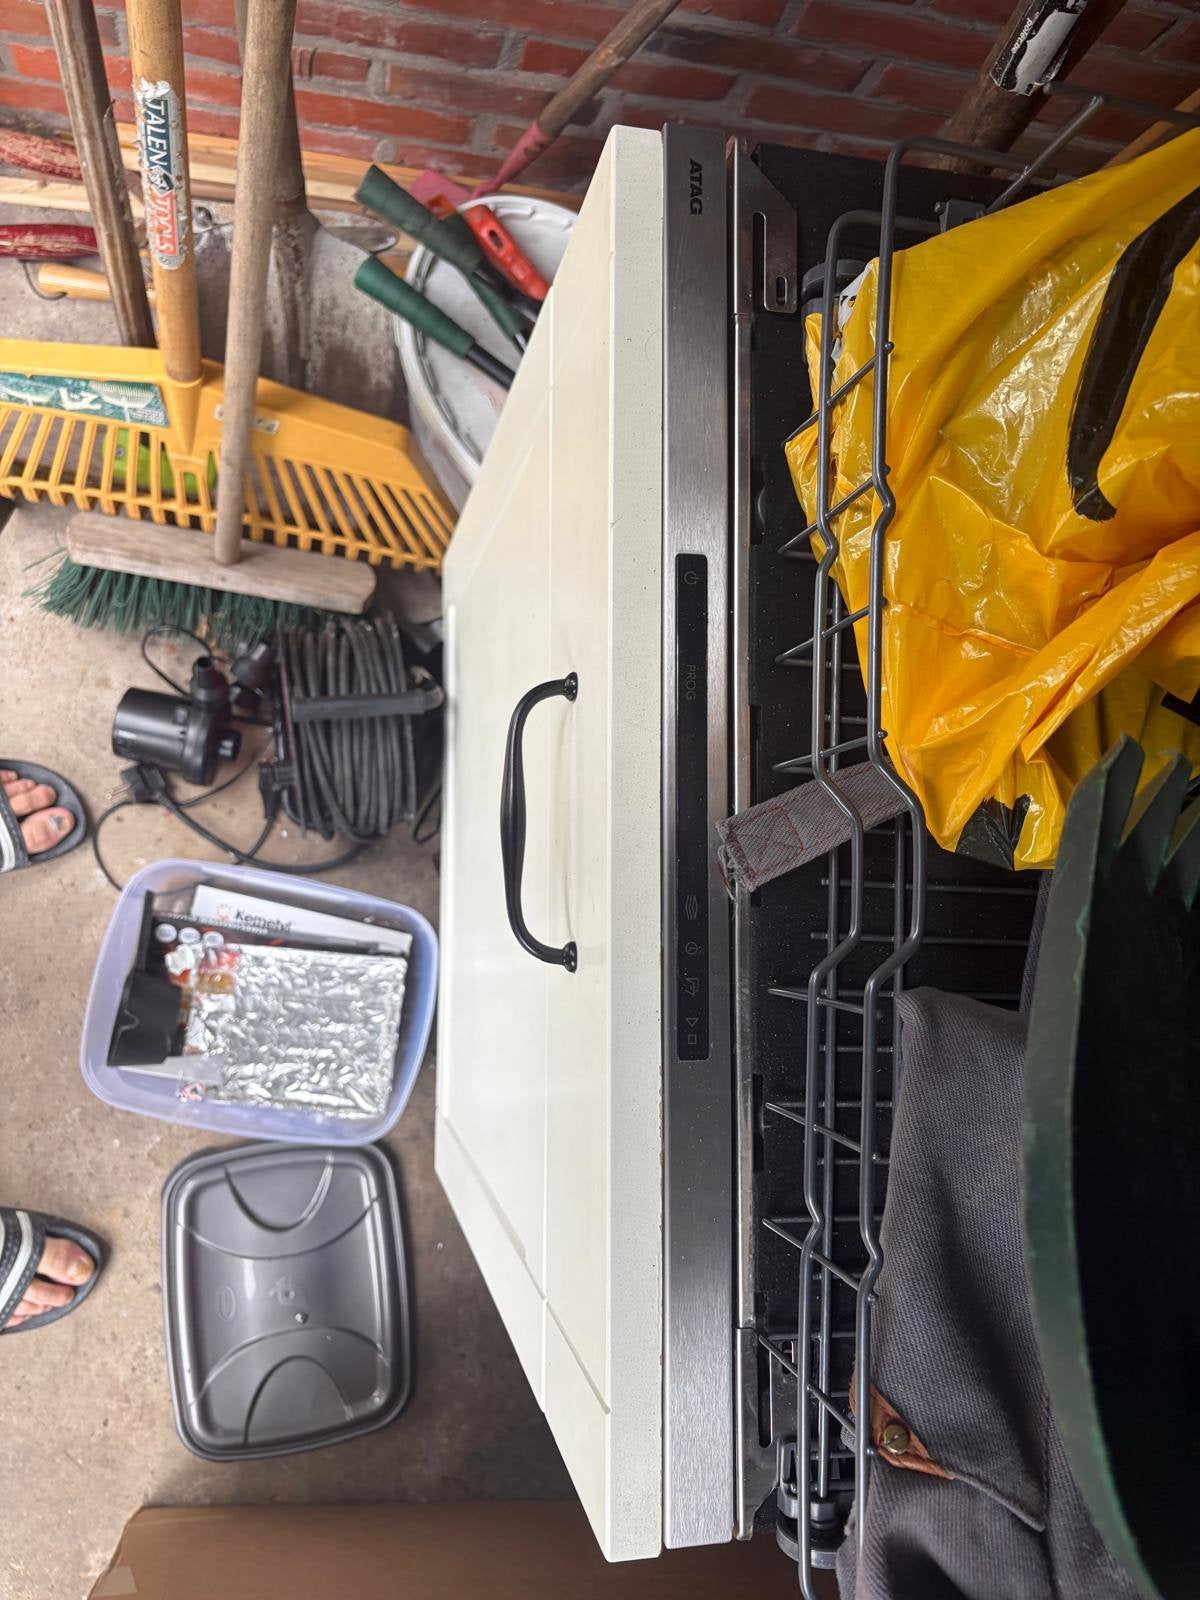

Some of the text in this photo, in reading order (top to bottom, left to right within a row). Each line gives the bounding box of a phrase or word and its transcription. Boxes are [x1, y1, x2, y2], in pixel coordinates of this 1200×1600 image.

[146, 98, 174, 255] TALEN TOOLS
[689, 158, 703, 215] ATAG
[686, 664, 697, 700] PROG
